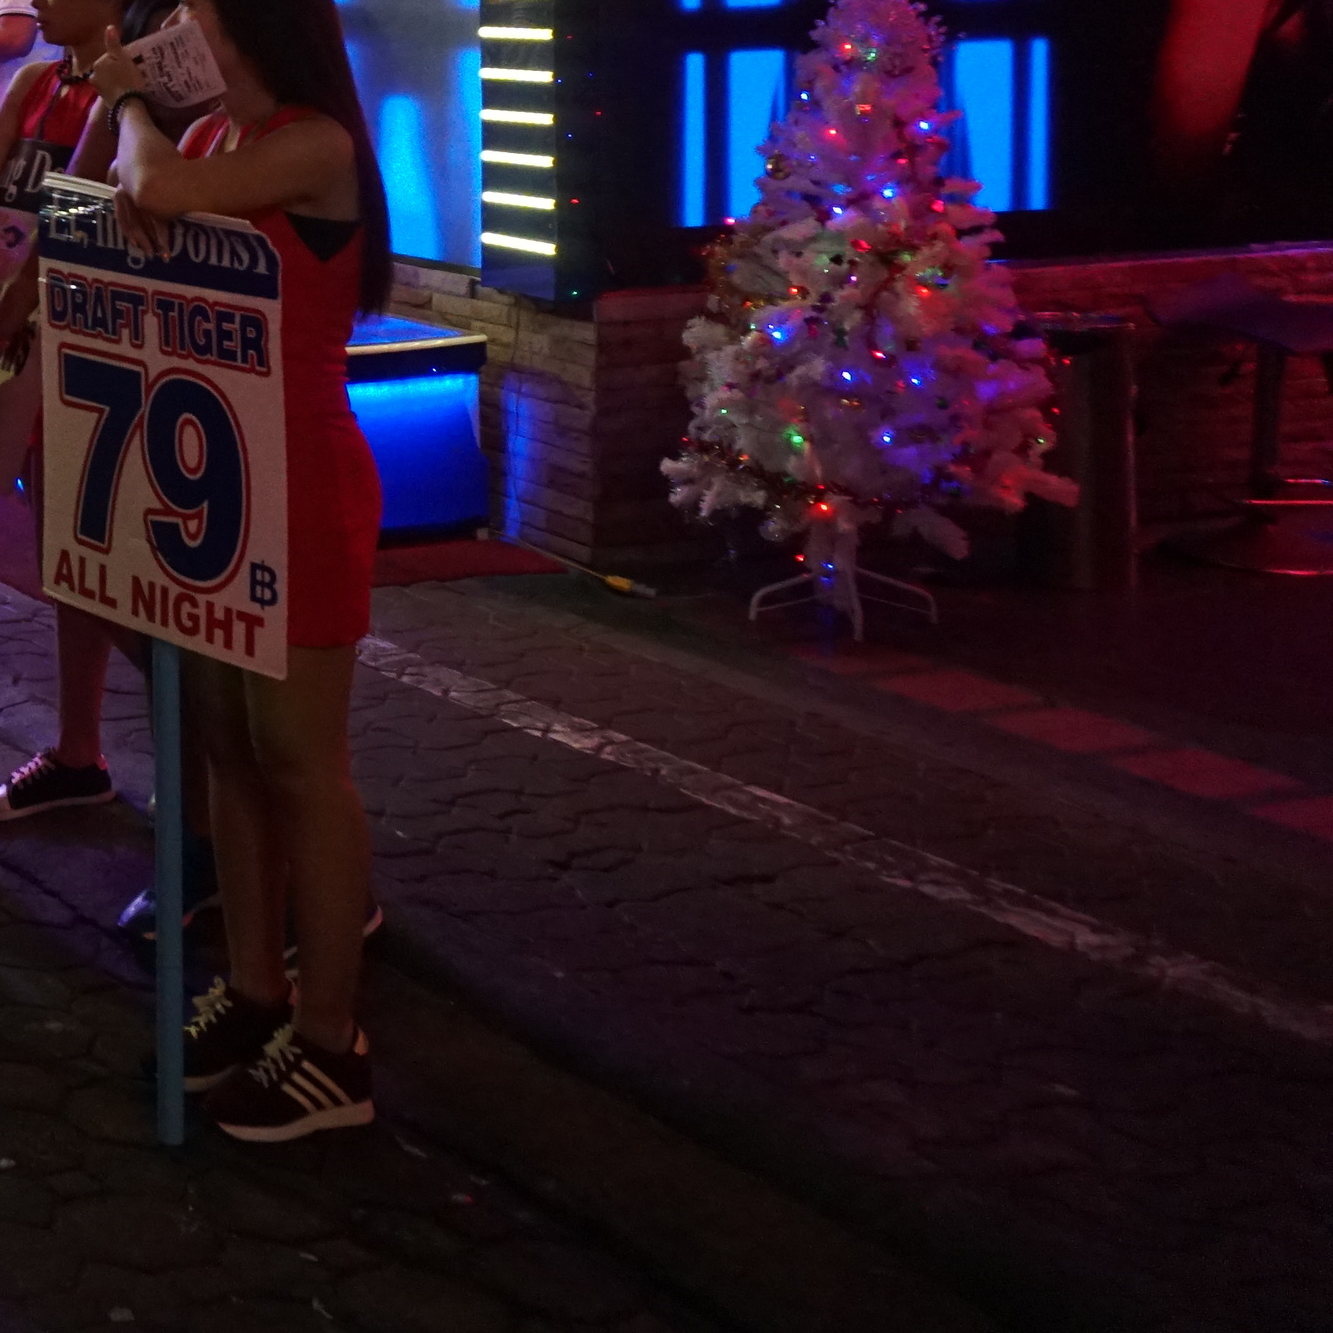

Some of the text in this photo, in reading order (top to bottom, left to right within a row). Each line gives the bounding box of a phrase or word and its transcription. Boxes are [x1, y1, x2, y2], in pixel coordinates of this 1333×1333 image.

[46, 268, 146, 348] DRAFT
[151, 285, 271, 376] TIGER
[58, 343, 251, 595] 79
[53, 549, 265, 658] ALL NIGHT
